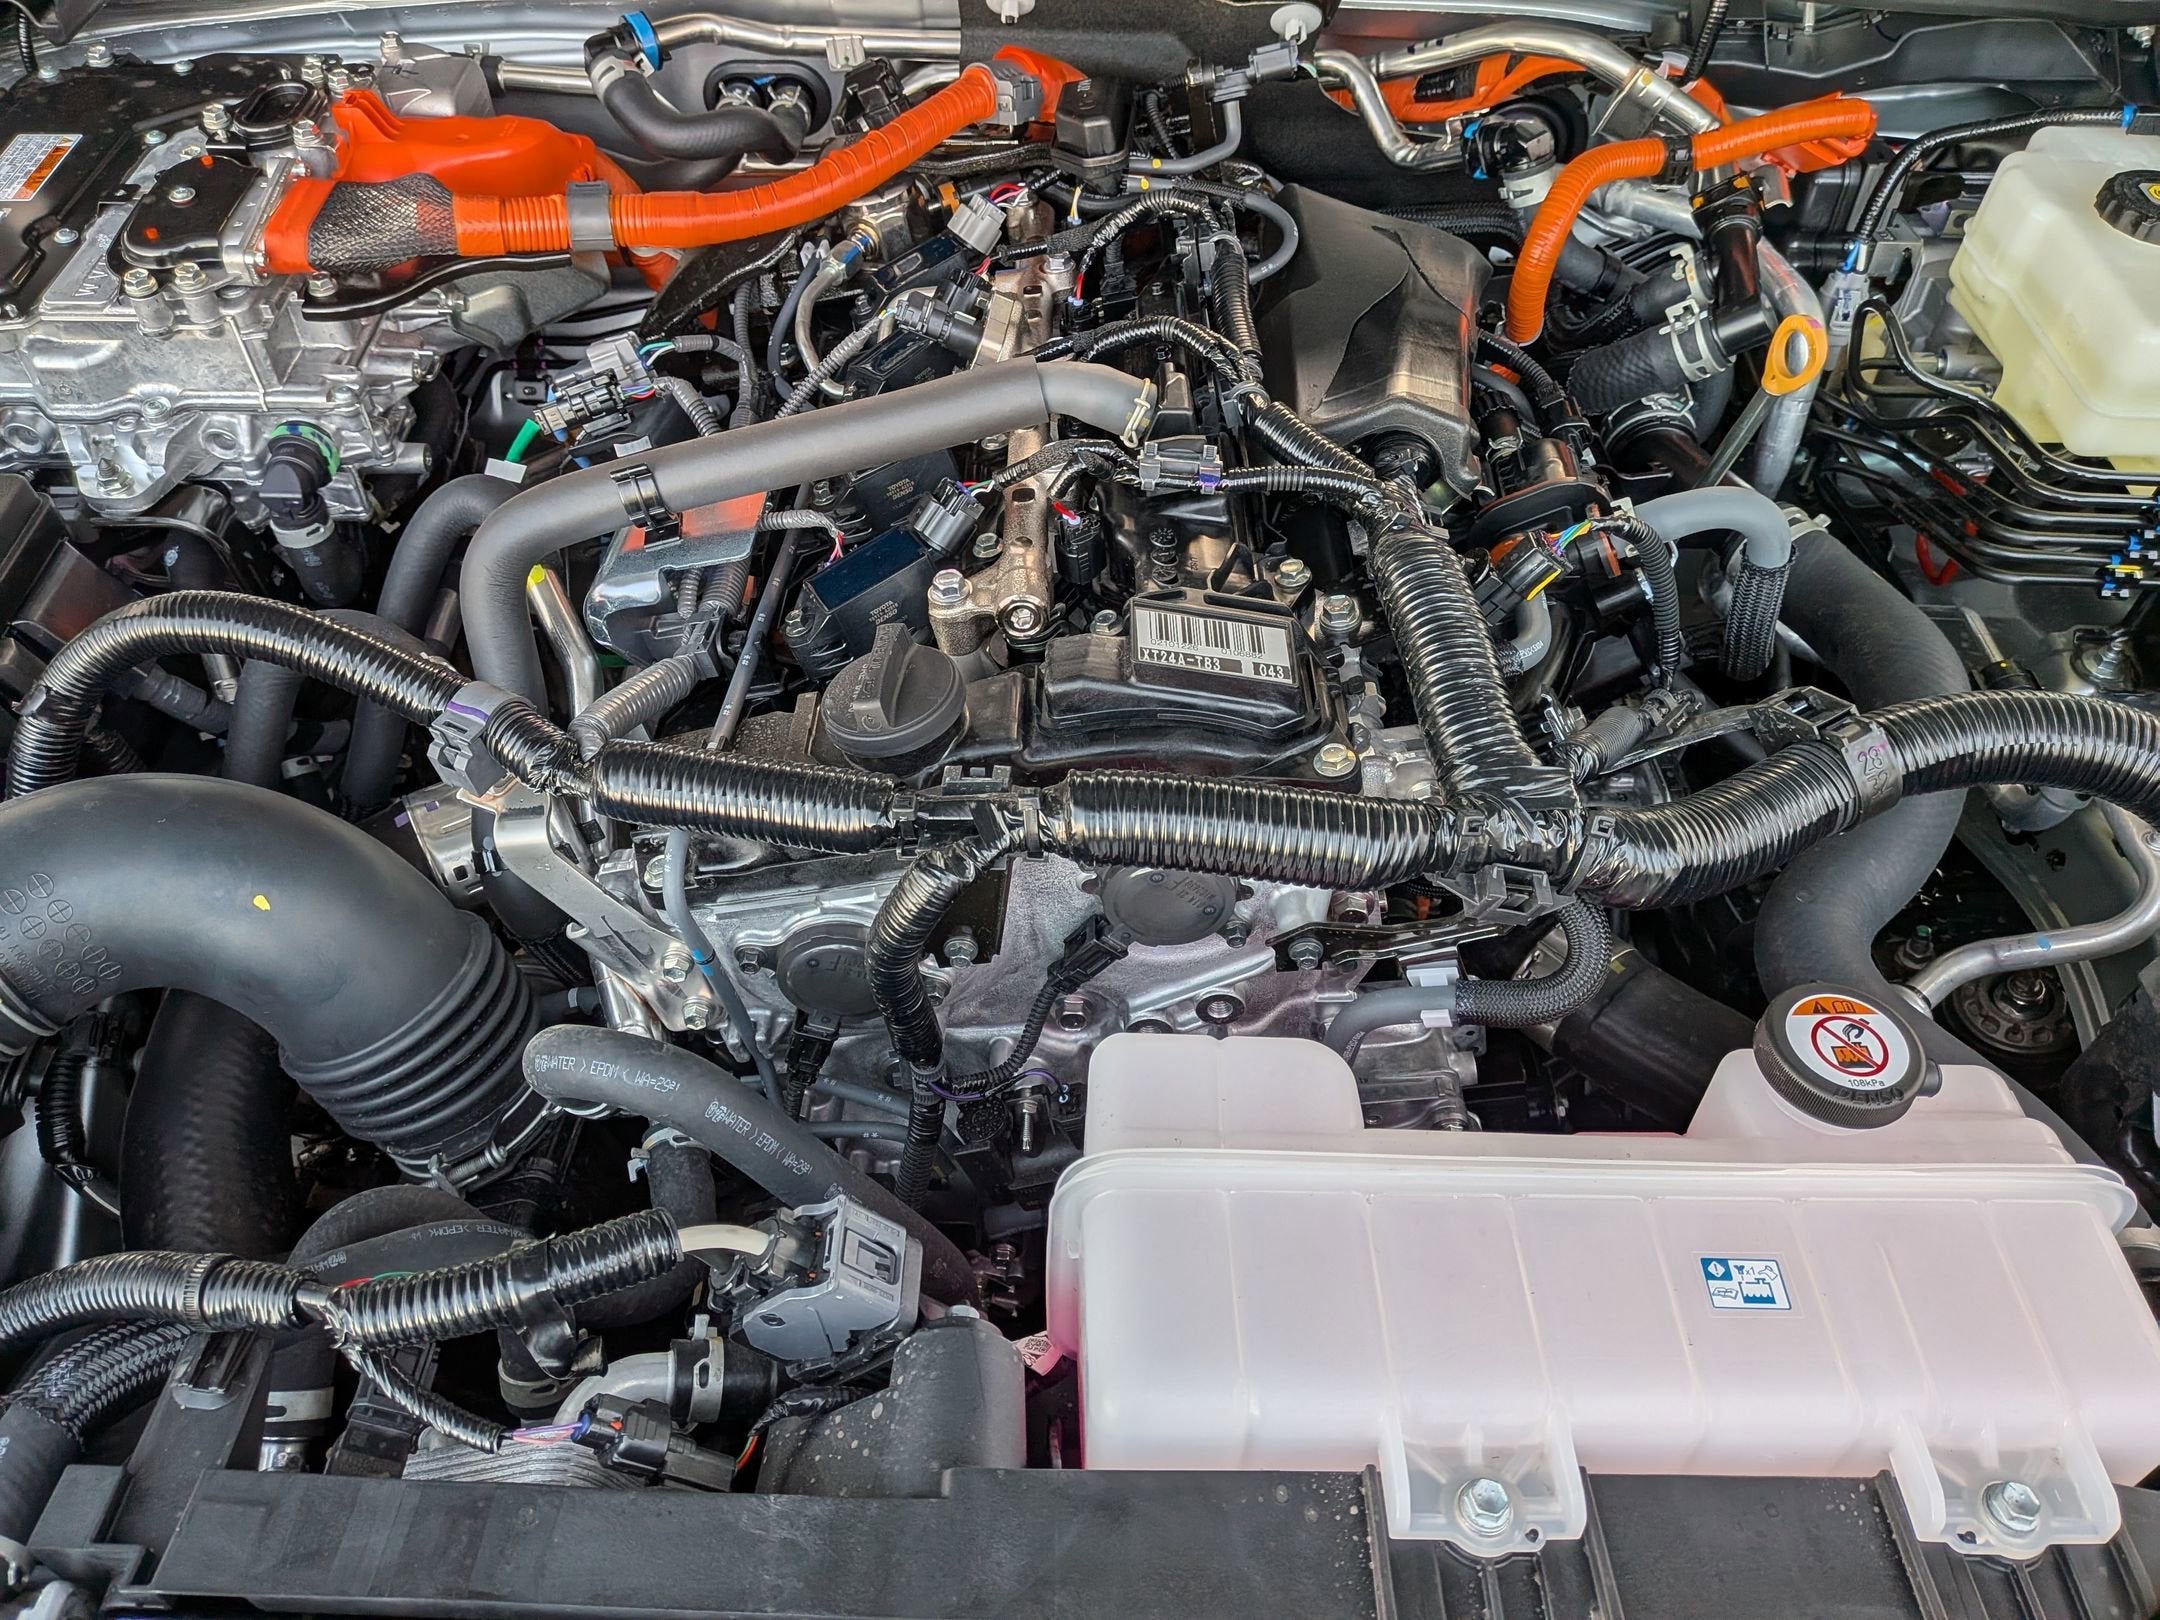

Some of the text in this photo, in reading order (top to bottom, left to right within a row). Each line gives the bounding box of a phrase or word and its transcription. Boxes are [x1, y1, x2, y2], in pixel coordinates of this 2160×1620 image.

[888, 478, 911, 491] TOYOTA
[893, 487, 914, 500] DENSO
[870, 600, 894, 616] TOYOTA
[875, 608, 898, 625] DENSO
[1143, 648, 1285, 679] XT24A-TB3 043
[1857, 745, 1883, 776] 28
[1847, 1079, 1885, 1088] 108kPa
[1833, 1086, 1905, 1106] DENSO
